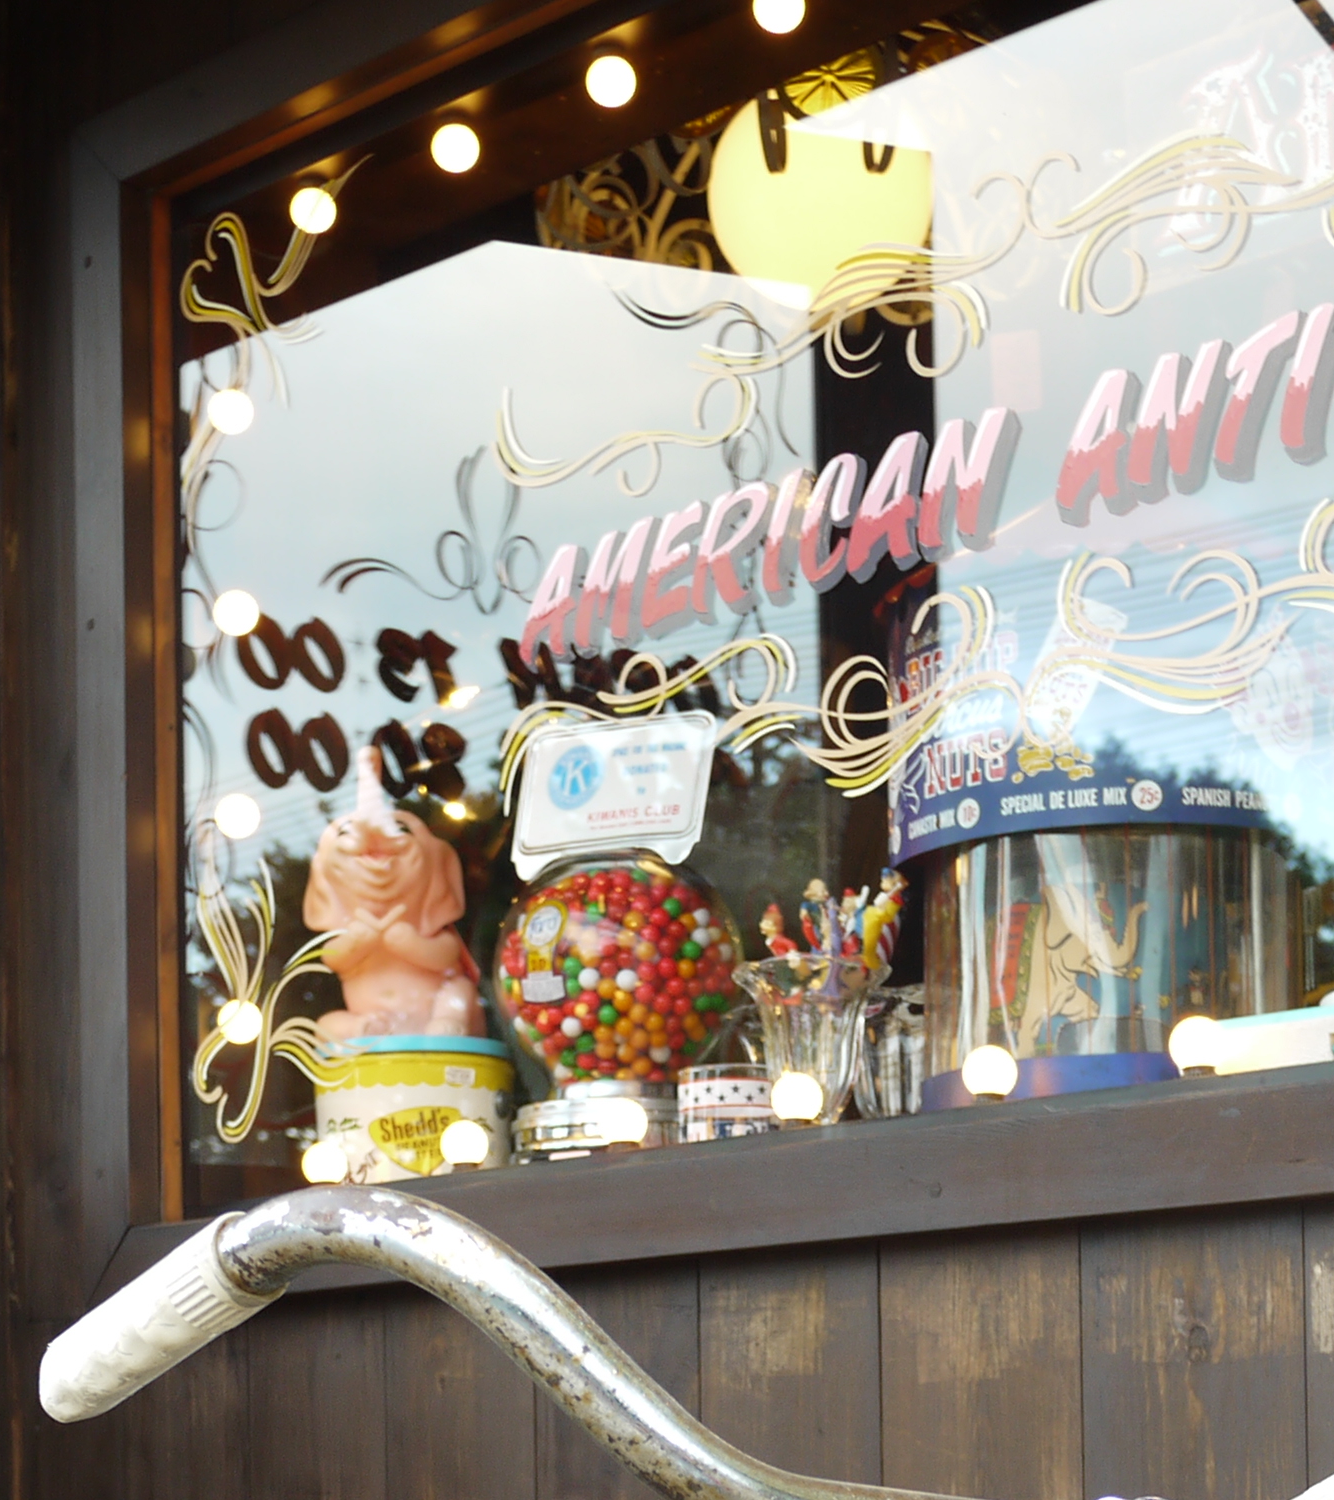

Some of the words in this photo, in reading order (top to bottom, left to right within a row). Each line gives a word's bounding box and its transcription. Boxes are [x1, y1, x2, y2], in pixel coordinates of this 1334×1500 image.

[516, 404, 1023, 667] AMERICAN
[923, 728, 1009, 799] NUTS
[586, 806, 639, 824] KIWANIS
[1000, 794, 1045, 815] SPECIAL
[1049, 792, 1067, 810] DE
[1068, 789, 1098, 808] LUXE
[1103, 788, 1128, 806] MIX
[1181, 787, 1231, 808] SPANISH
[379, 1107, 451, 1143] Shedd's
